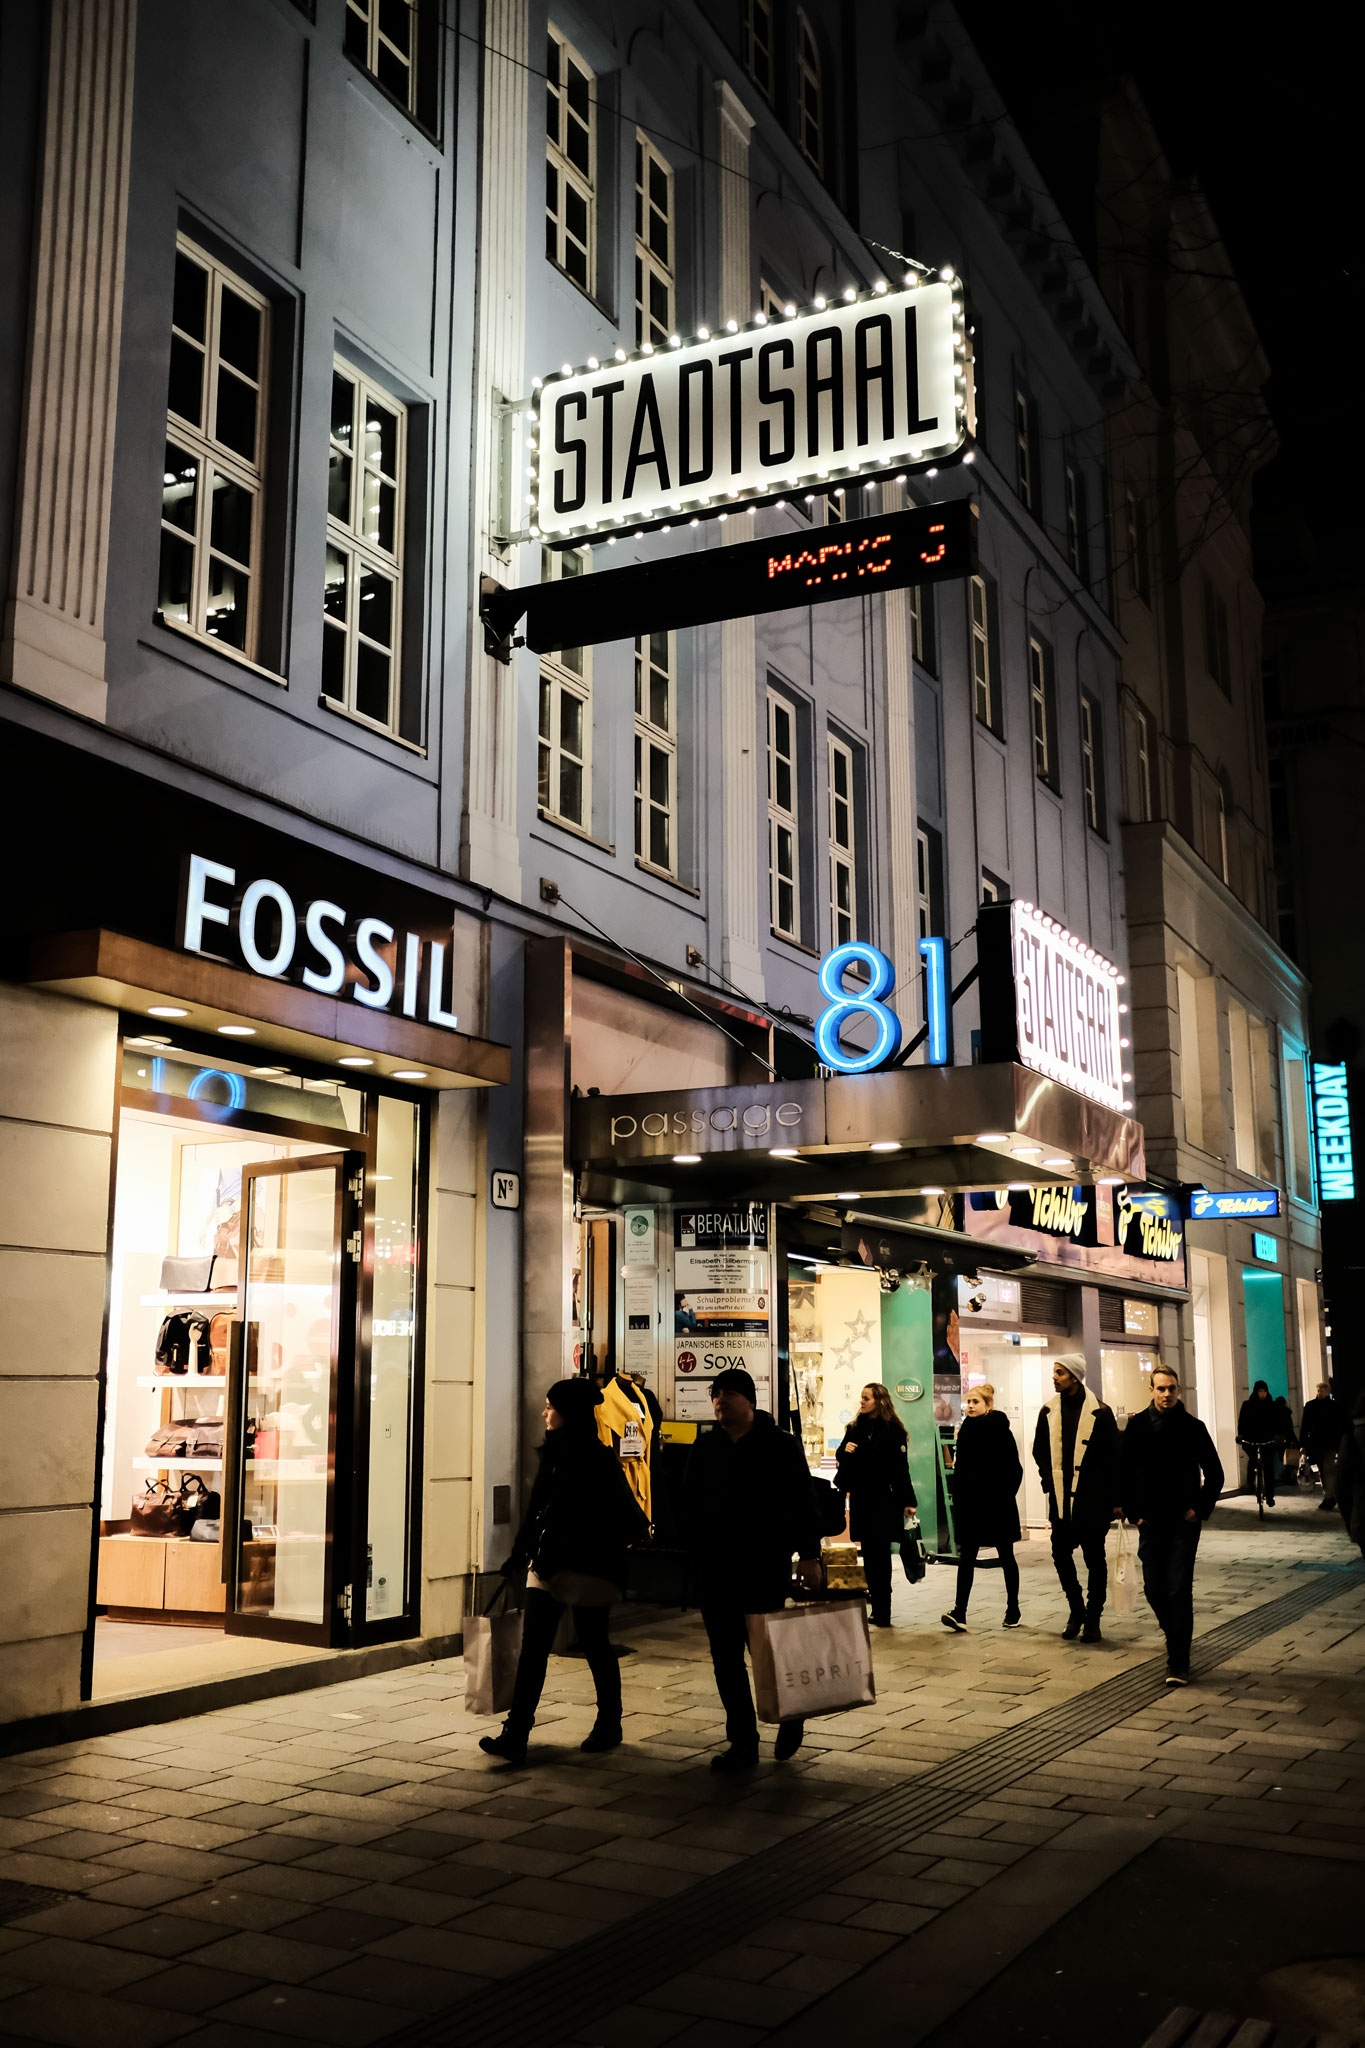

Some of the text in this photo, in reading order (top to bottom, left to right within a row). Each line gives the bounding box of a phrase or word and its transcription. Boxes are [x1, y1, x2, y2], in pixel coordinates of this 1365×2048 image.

[554, 306, 938, 514] STADTSAAL
[183, 853, 459, 1029] FOSSIL
[814, 937, 953, 1073] 81
[1018, 927, 1119, 1091] STADTSAAL
[611, 1102, 803, 1146] passage
[697, 1213, 765, 1234] BERATUNG
[1029, 1186, 1088, 1237] Tchibo
[1216, 1197, 1274, 1214] Tchibo
[1140, 1211, 1183, 1261] Tchibo
[676, 1340, 767, 1349] JAPANISCHES RESTAURANT
[784, 1660, 864, 1687] ESPRIT
